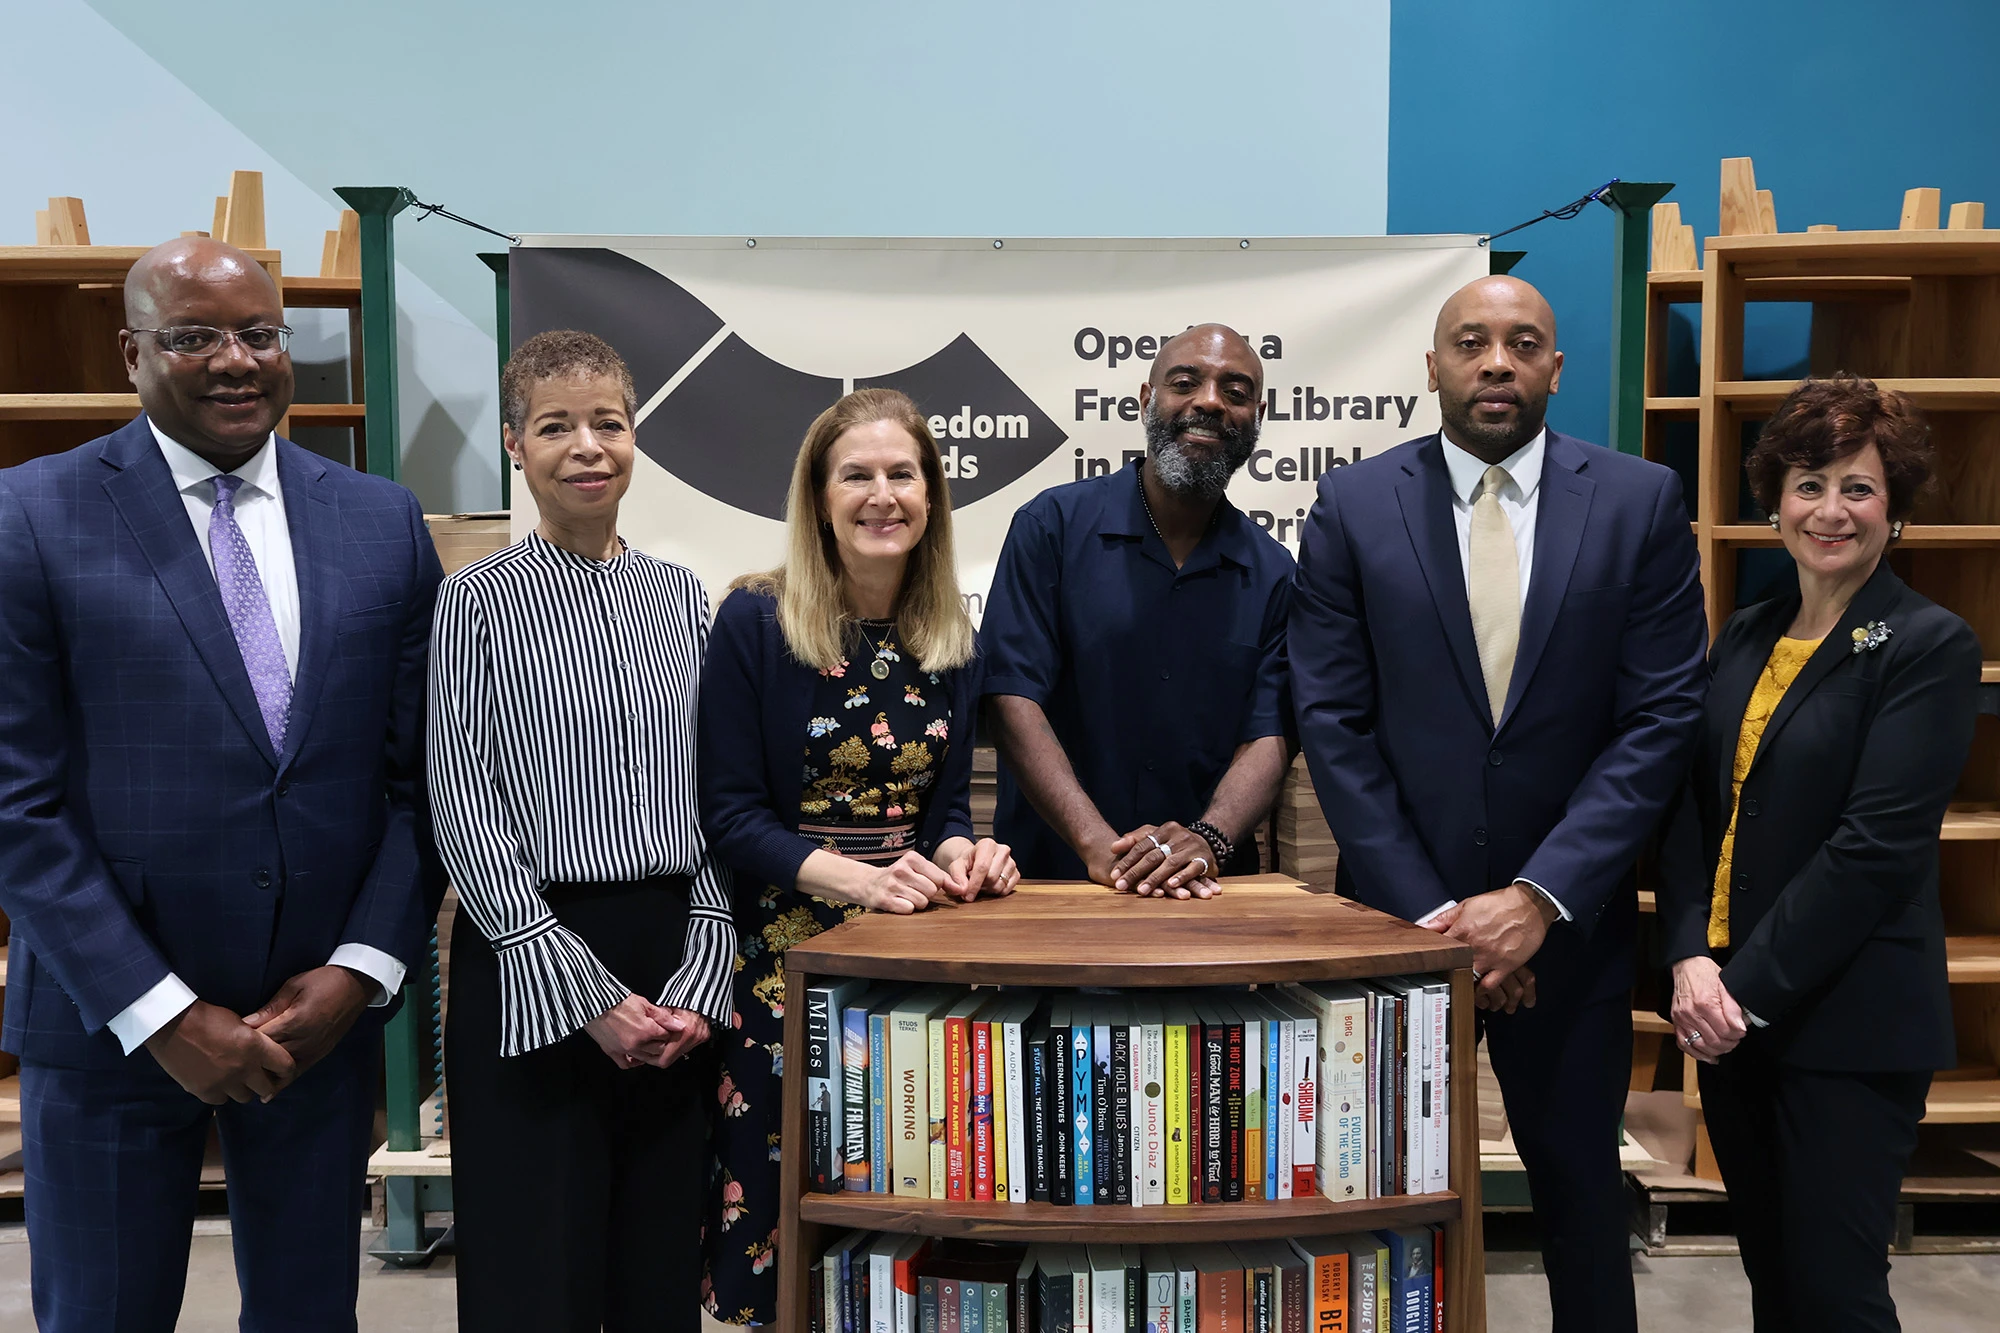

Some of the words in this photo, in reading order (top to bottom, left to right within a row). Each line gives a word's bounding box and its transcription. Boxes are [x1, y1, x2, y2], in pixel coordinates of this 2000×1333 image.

[1259, 334, 1283, 360] a
[1267, 386, 1419, 429] Library
[1074, 447, 1112, 479] in
[1435, 998, 1443, 1012] From
[1344, 1016, 1353, 1037] BORG
[1435, 1013, 1443, 1023] the
[1435, 1024, 1443, 1036] War
[809, 1000, 828, 1068] Miles
[952, 1024, 959, 1041] WE
[977, 1030, 986, 1051] SING,
[1174, 1030, 1179, 1038] we
[1230, 1027, 1240, 1044] THE
[1115, 1031, 1127, 1062] BLACK
[1207, 1041, 1221, 1053] A
[1230, 1046, 1240, 1064] HOT
[1434, 1047, 1443, 1069] Poverty
[846, 1041, 863, 1104] JONATHAN
[977, 1053, 986, 1093] UNBURIED,
[1033, 1047, 1041, 1075] STUART
[1209, 1054, 1221, 1077] Good
[1056, 1034, 1065, 1123] COUNTERNARRATIVES
[1097, 1076, 1107, 1095] Tim
[1115, 1066, 1127, 1093] HOLE
[1209, 1077, 1221, 1104] MAN
[1230, 1067, 1240, 1091] ZONE
[1435, 1078, 1443, 1088] the
[903, 1069, 916, 1140] WORKING
[977, 1094, 986, 1113] SING
[1298, 1082, 1313, 1122] SHIBUMI
[1434, 1089, 1442, 1101] War
[1115, 1097, 1127, 1130] BLUES
[1148, 1101, 1158, 1137] Junot
[1339, 1117, 1349, 1128] OF
[1434, 1111, 1442, 1129] Crime
[846, 1108, 863, 1162] FRANZEN
[977, 1121, 986, 1152] JESMYN
[1035, 1112, 1043, 1142] FATEFUL
[1209, 1118, 1221, 1148] HARD
[1058, 1131, 1066, 1152] JOHN
[1117, 1133, 1125, 1158] Janna
[1339, 1132, 1349, 1149] THE
[1351, 1116, 1361, 1165] EVOLUTION
[1148, 1141, 1160, 1169] Díaz
[1208, 1149, 1219, 1159] to
[1339, 1152, 1349, 1179] WORD
[977, 1155, 986, 1179] WARD
[1058, 1154, 1066, 1179] KEENE
[1117, 1160, 1125, 1181] Levin
[1208, 1159, 1220, 1182] Find
[1321, 1264, 1330, 1303] SAPOLSKY
[1332, 1262, 1341, 1291] ROBERT
[1260, 1306, 1267, 1314] de
[1362, 1273, 1375, 1325] RESIDUE
[1381, 1298, 1390, 1319] Brown
